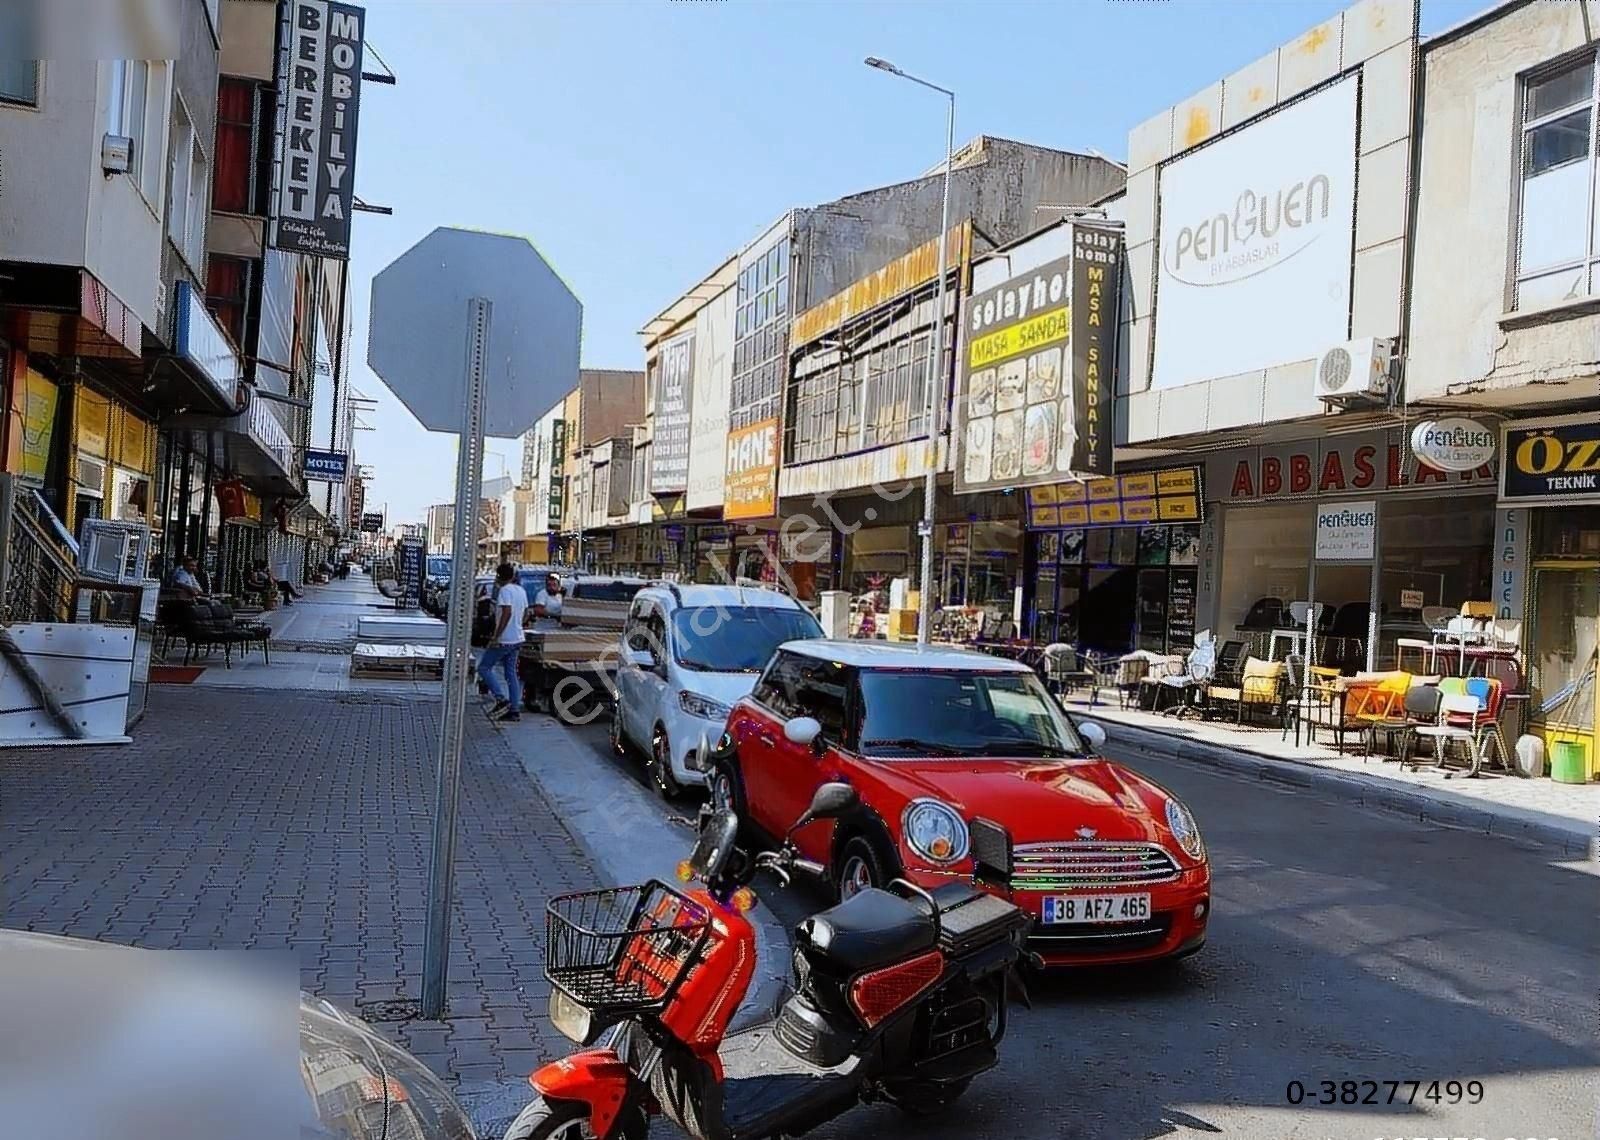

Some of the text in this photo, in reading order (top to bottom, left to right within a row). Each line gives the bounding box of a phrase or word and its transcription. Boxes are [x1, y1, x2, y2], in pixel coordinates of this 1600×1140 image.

[287, 4, 320, 212] BEREKET
[1075, 231, 1117, 248] solay
[1075, 248, 1116, 265] home
[1088, 267, 1103, 326] MASA
[974, 336, 1009, 361] MASA
[1088, 349, 1102, 468] SANDALYE
[1055, 897, 1147, 921] 38 AFZ 465
